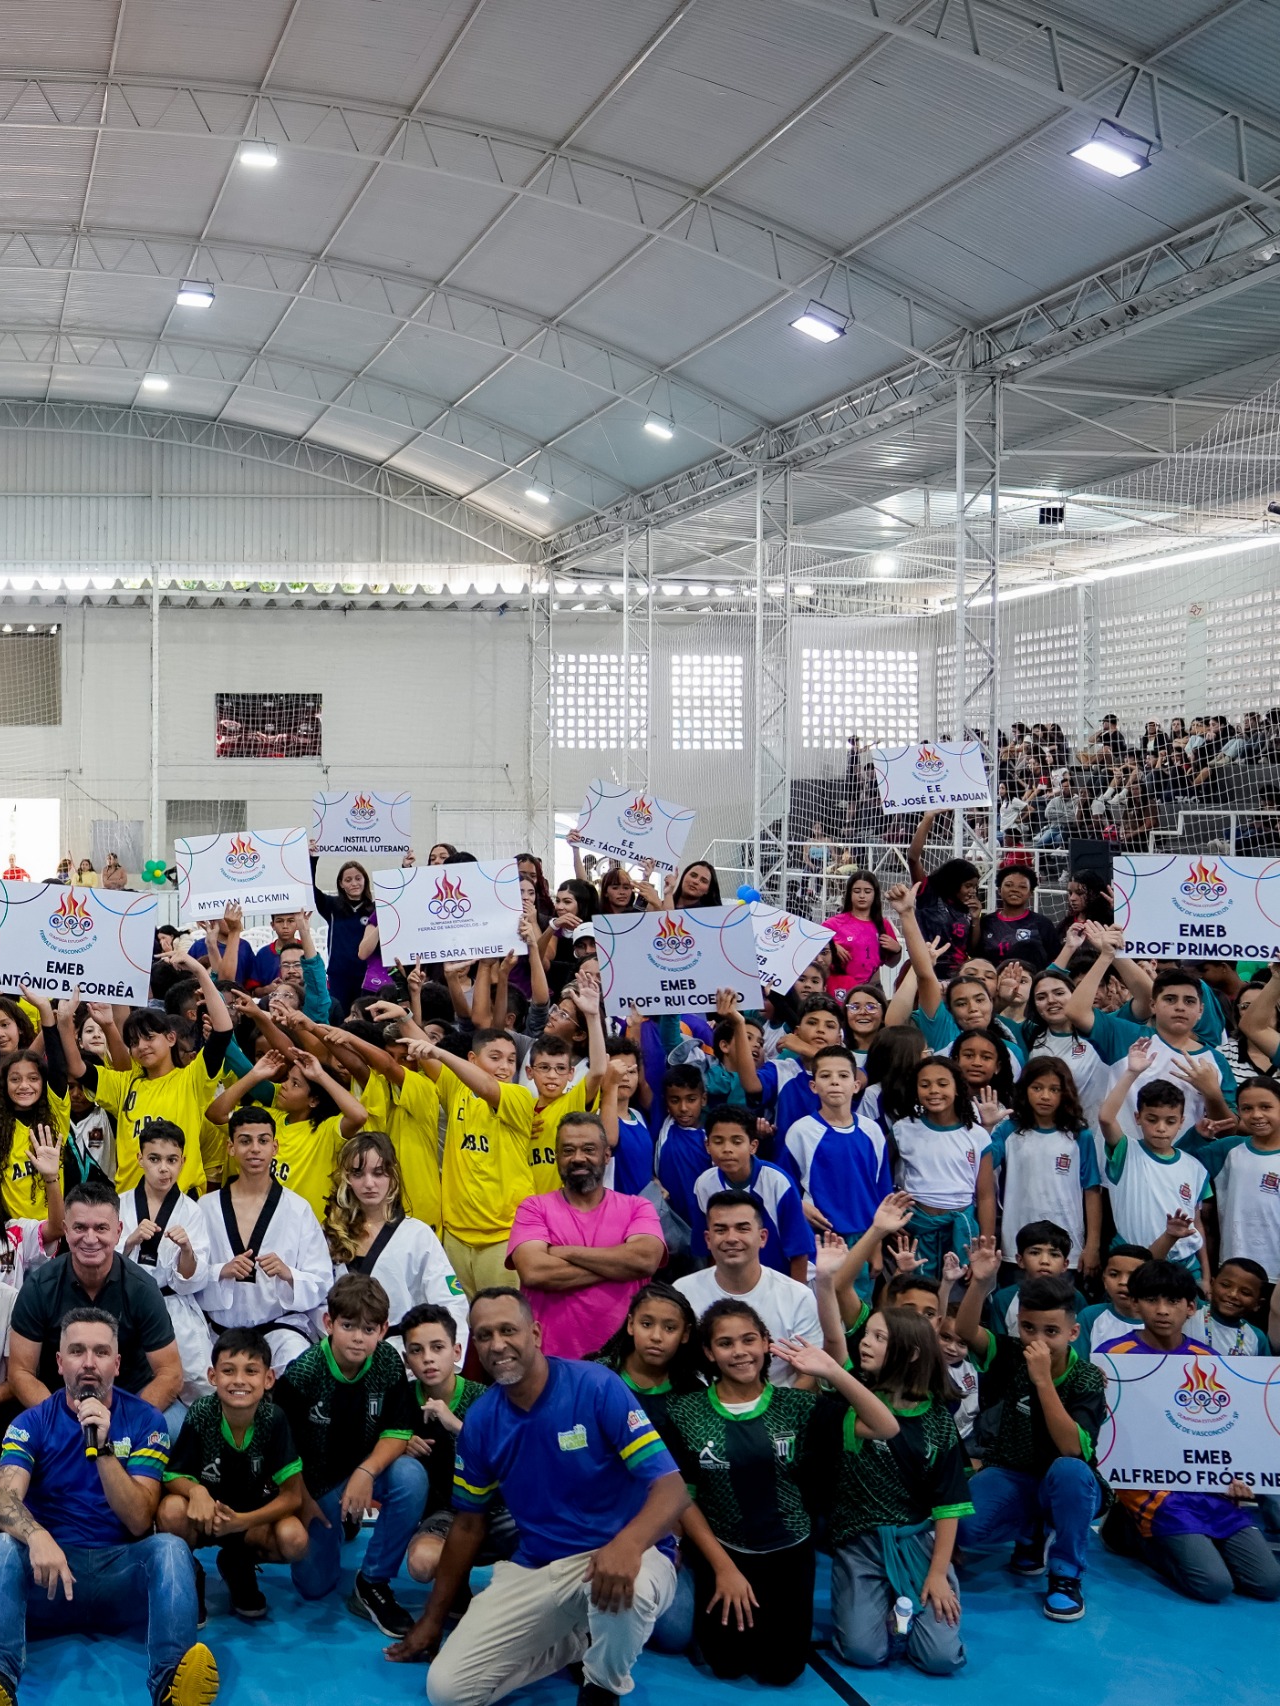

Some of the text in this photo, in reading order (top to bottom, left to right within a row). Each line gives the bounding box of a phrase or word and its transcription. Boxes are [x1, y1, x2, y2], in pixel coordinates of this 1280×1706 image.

[926, 785, 942, 793] E.E
[884, 800, 900, 808] DR.
[901, 795, 927, 806] JOSÉ
[939, 795, 949, 803] V.
[951, 792, 988, 802] RADUAN
[342, 836, 382, 844] INSTITUTO
[621, 839, 635, 849] E.E
[369, 845, 410, 853] LUTERANO
[580, 836, 674, 872] REF. TÁCITO ZANETTA
[244, 893, 290, 904] ALCKMIN
[1179, 923, 1227, 937] EMEB
[409, 945, 504, 961] EMEB SARA TINEUE
[1177, 942, 1280, 959] PRIMOROSA
[46, 960, 85, 976] EMEB
[62, 980, 73, 992] B.
[78, 980, 135, 999] CORRÊA
[660, 978, 697, 991] EMEB
[665, 995, 686, 1007] RUI
[688, 991, 745, 1005] COEO
[1183, 1449, 1233, 1465] EMEB
[1109, 1468, 1192, 1485] ALFREDO
